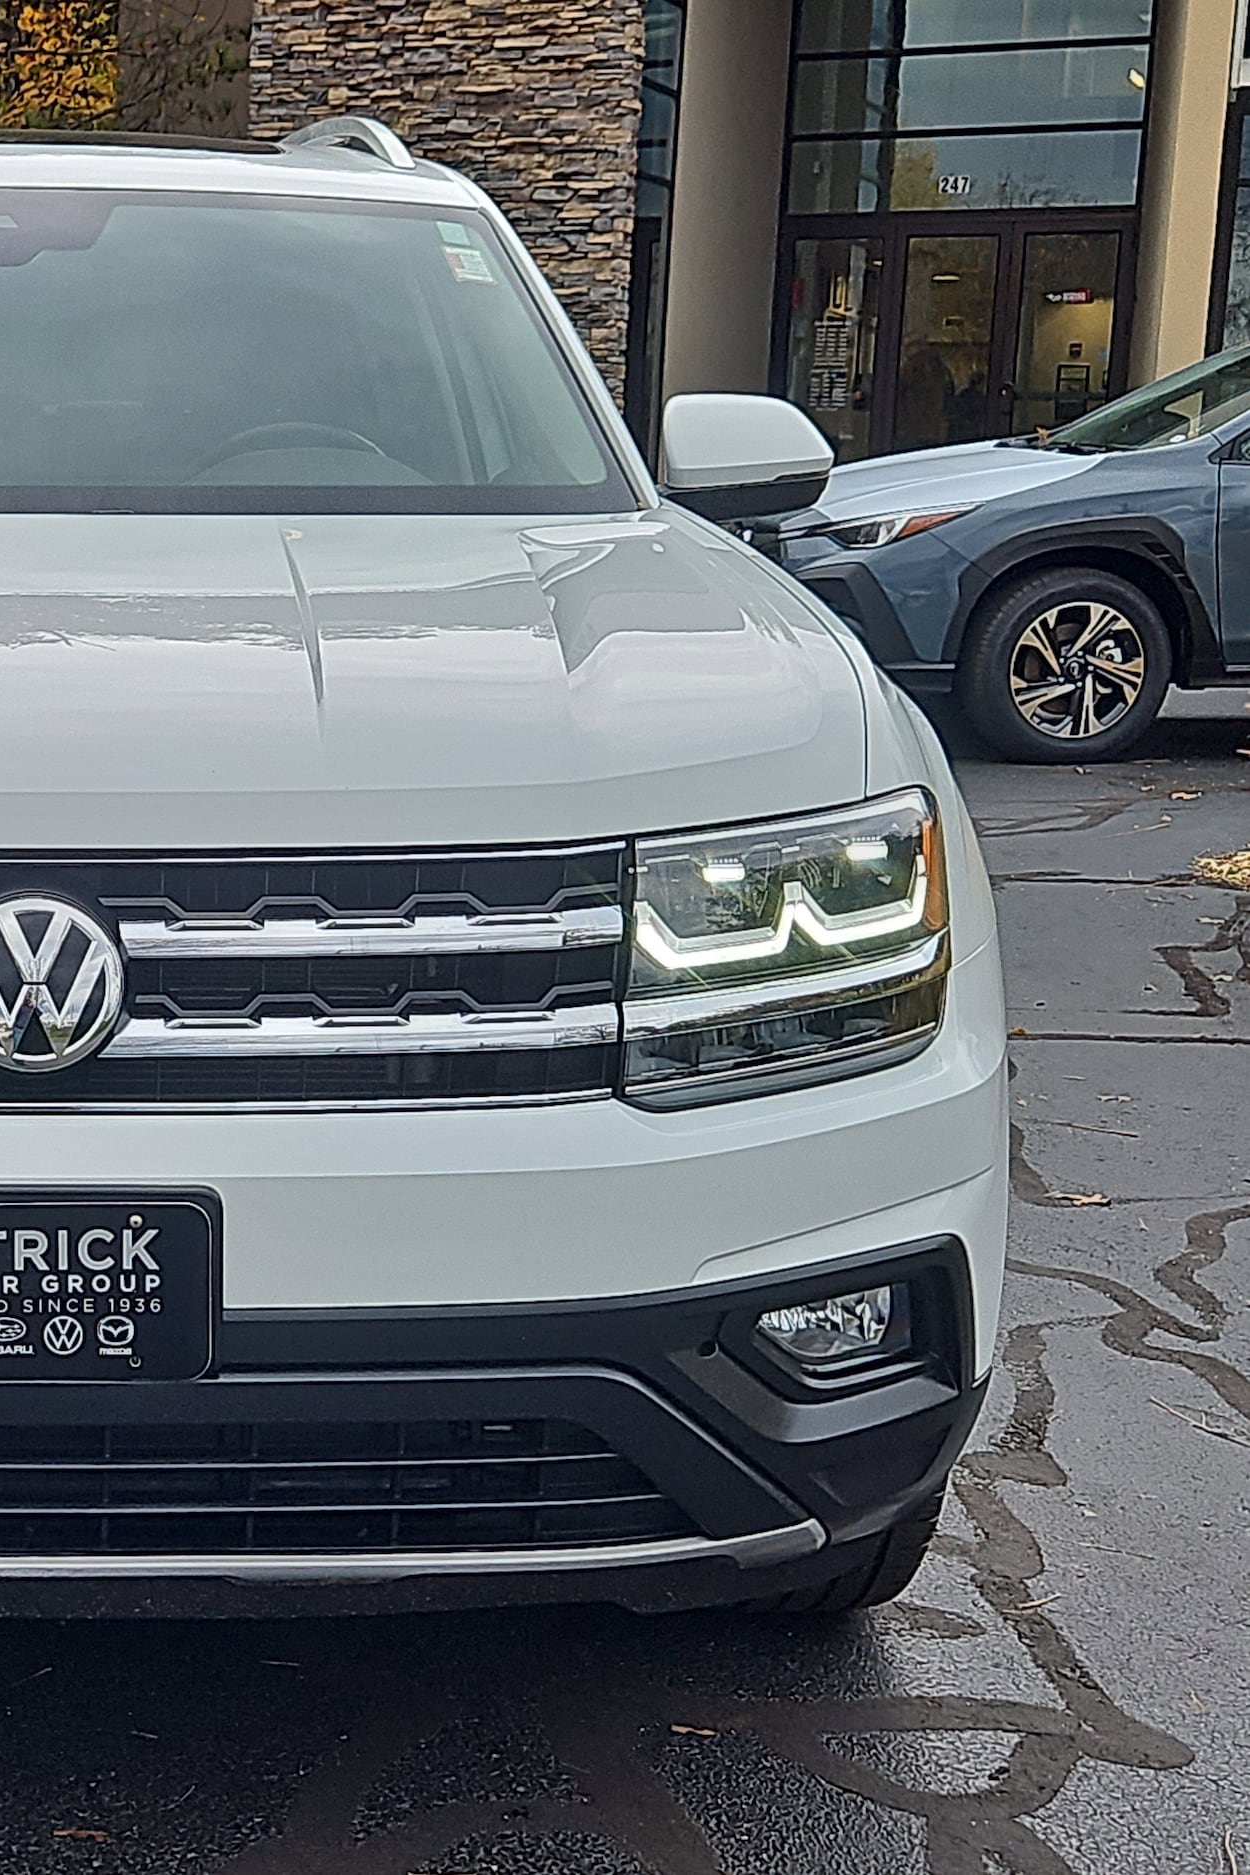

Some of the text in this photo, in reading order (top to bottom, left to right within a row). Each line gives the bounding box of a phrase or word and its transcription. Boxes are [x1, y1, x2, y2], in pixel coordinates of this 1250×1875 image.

[939, 176, 970, 194] 247
[42, 1274, 161, 1294] GROUP
[22, 1298, 95, 1314] SINCE
[108, 1298, 162, 1313] 1936
